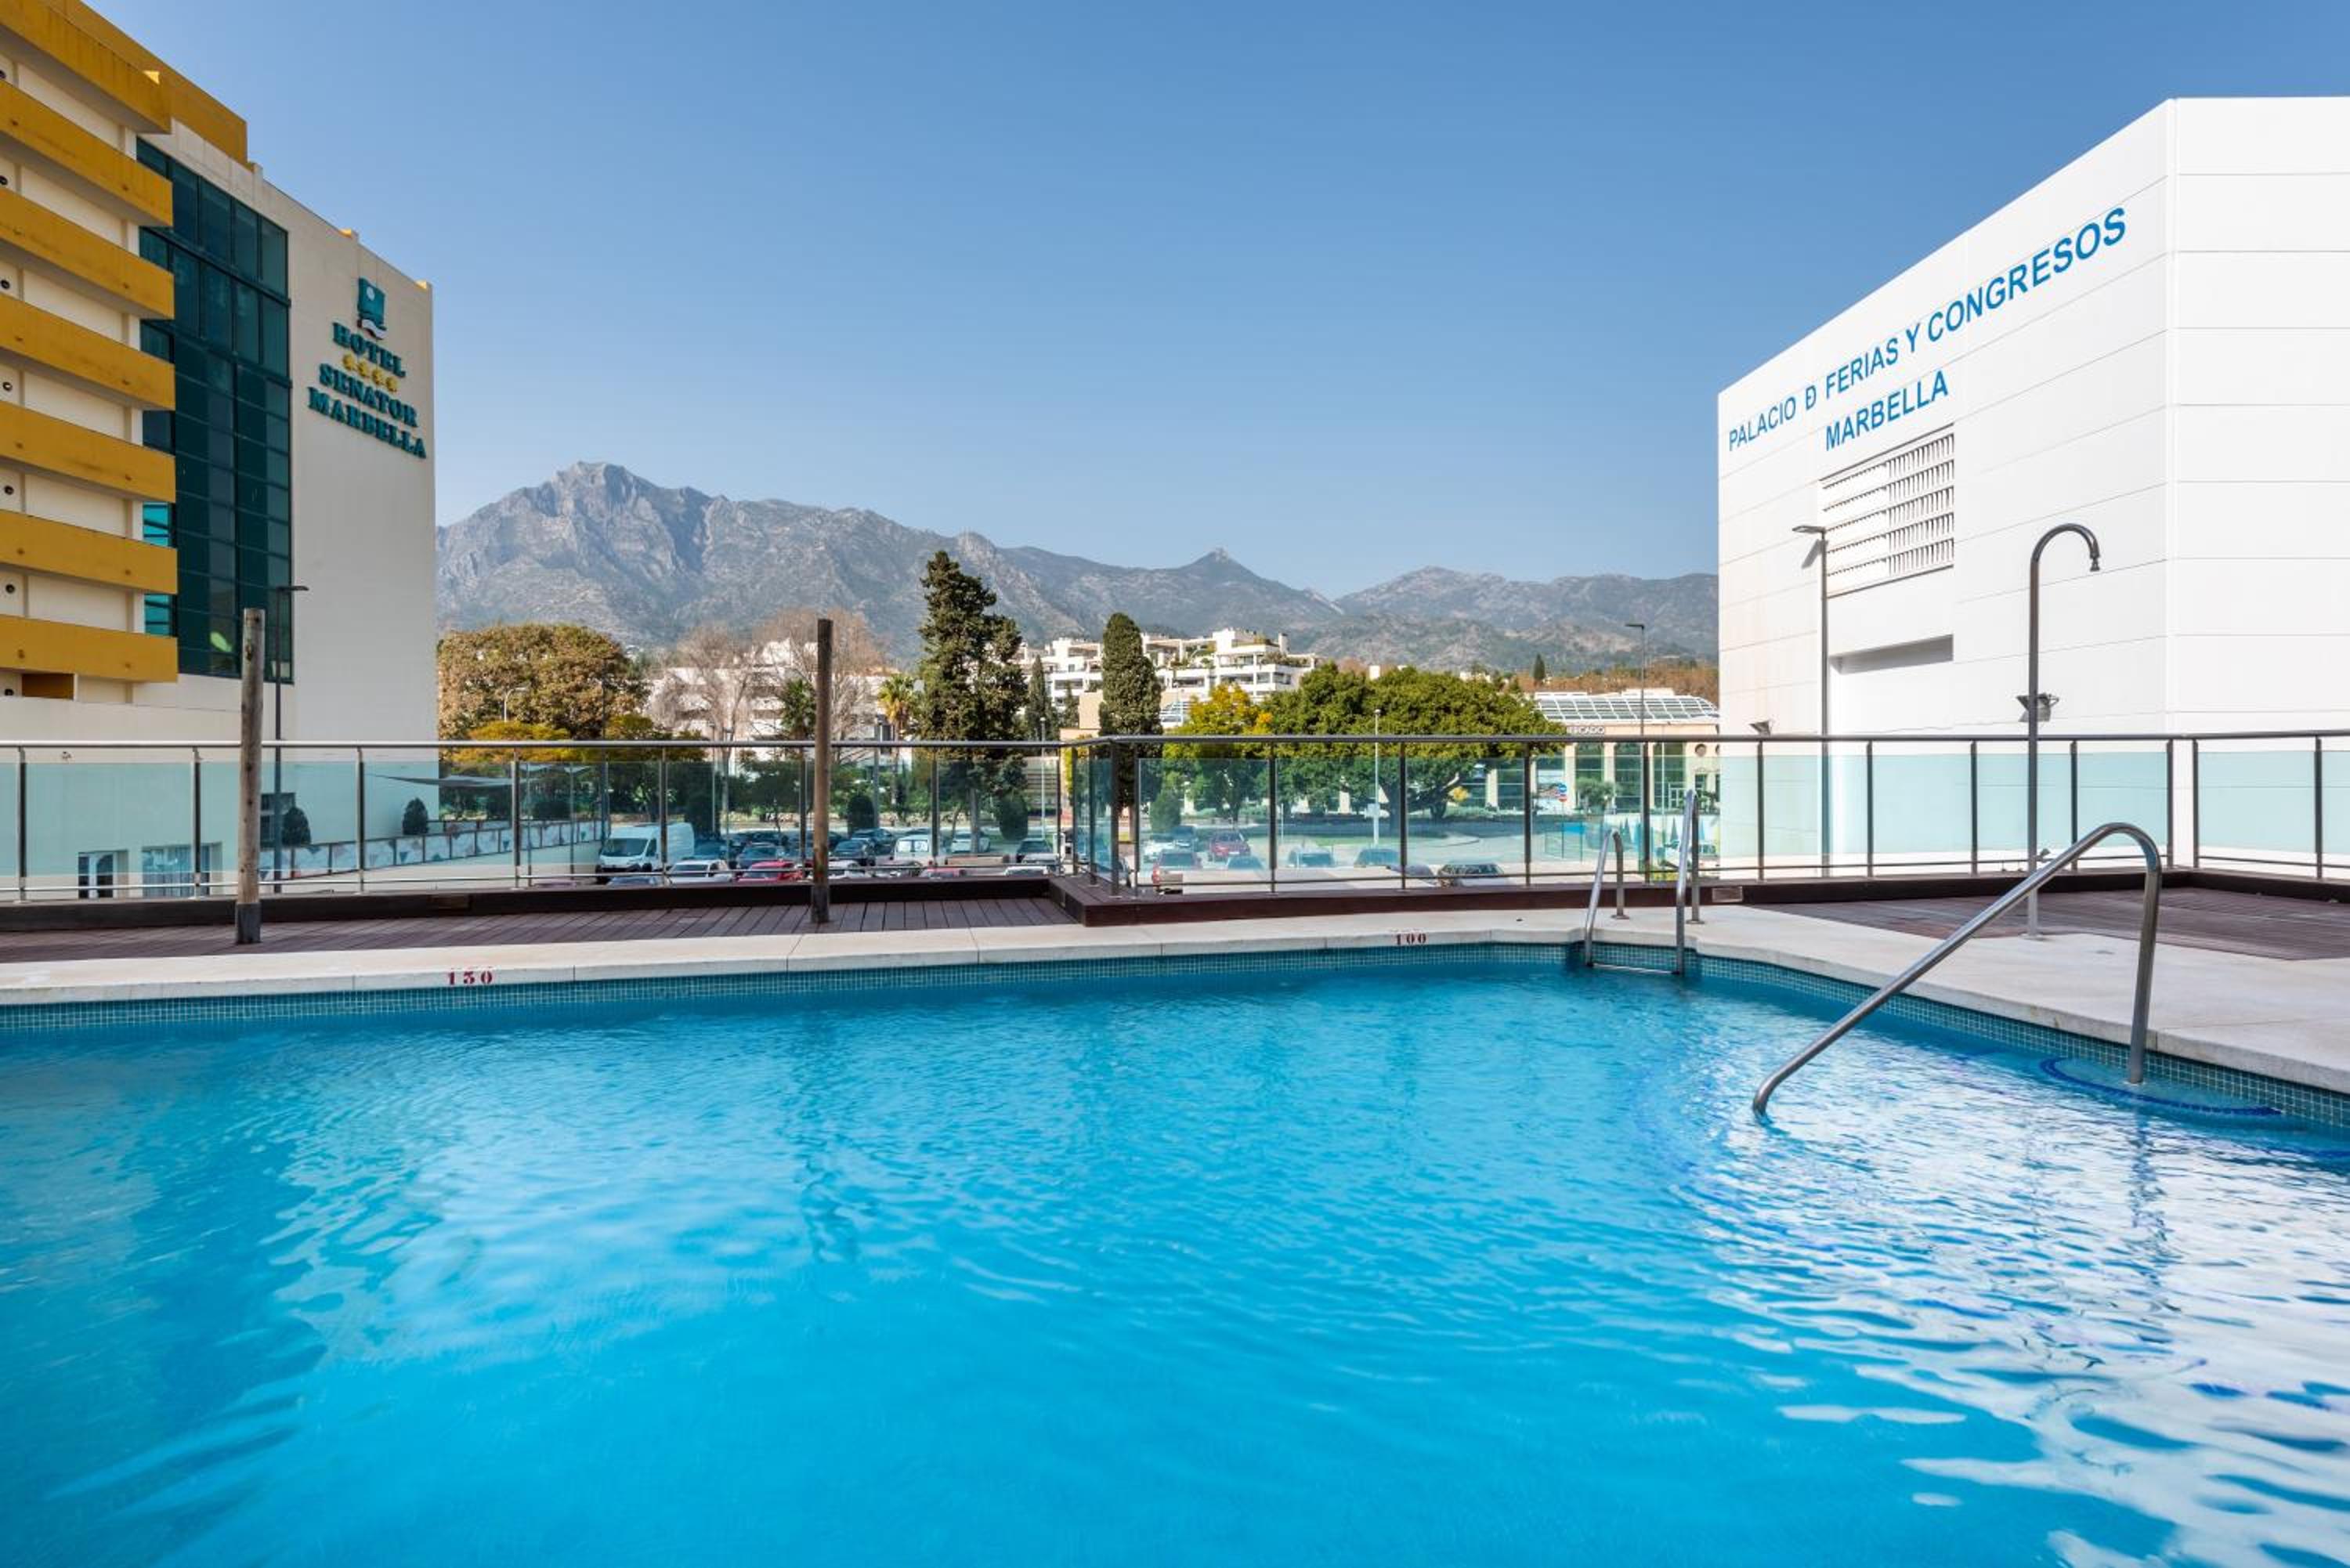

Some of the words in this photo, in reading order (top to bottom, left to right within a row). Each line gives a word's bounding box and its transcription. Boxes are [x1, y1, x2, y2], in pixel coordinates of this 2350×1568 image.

[332, 322, 406, 378] HOTEL
[1728, 396, 1796, 452] PALACIO
[1826, 338, 1899, 399] FERIAS
[1906, 323, 1921, 352] Y
[1928, 207, 2126, 341] CONGRESOS
[308, 387, 427, 459] MARBELLA
[319, 363, 418, 428] SENATOR
[1826, 370, 1948, 452] MARBELLA
